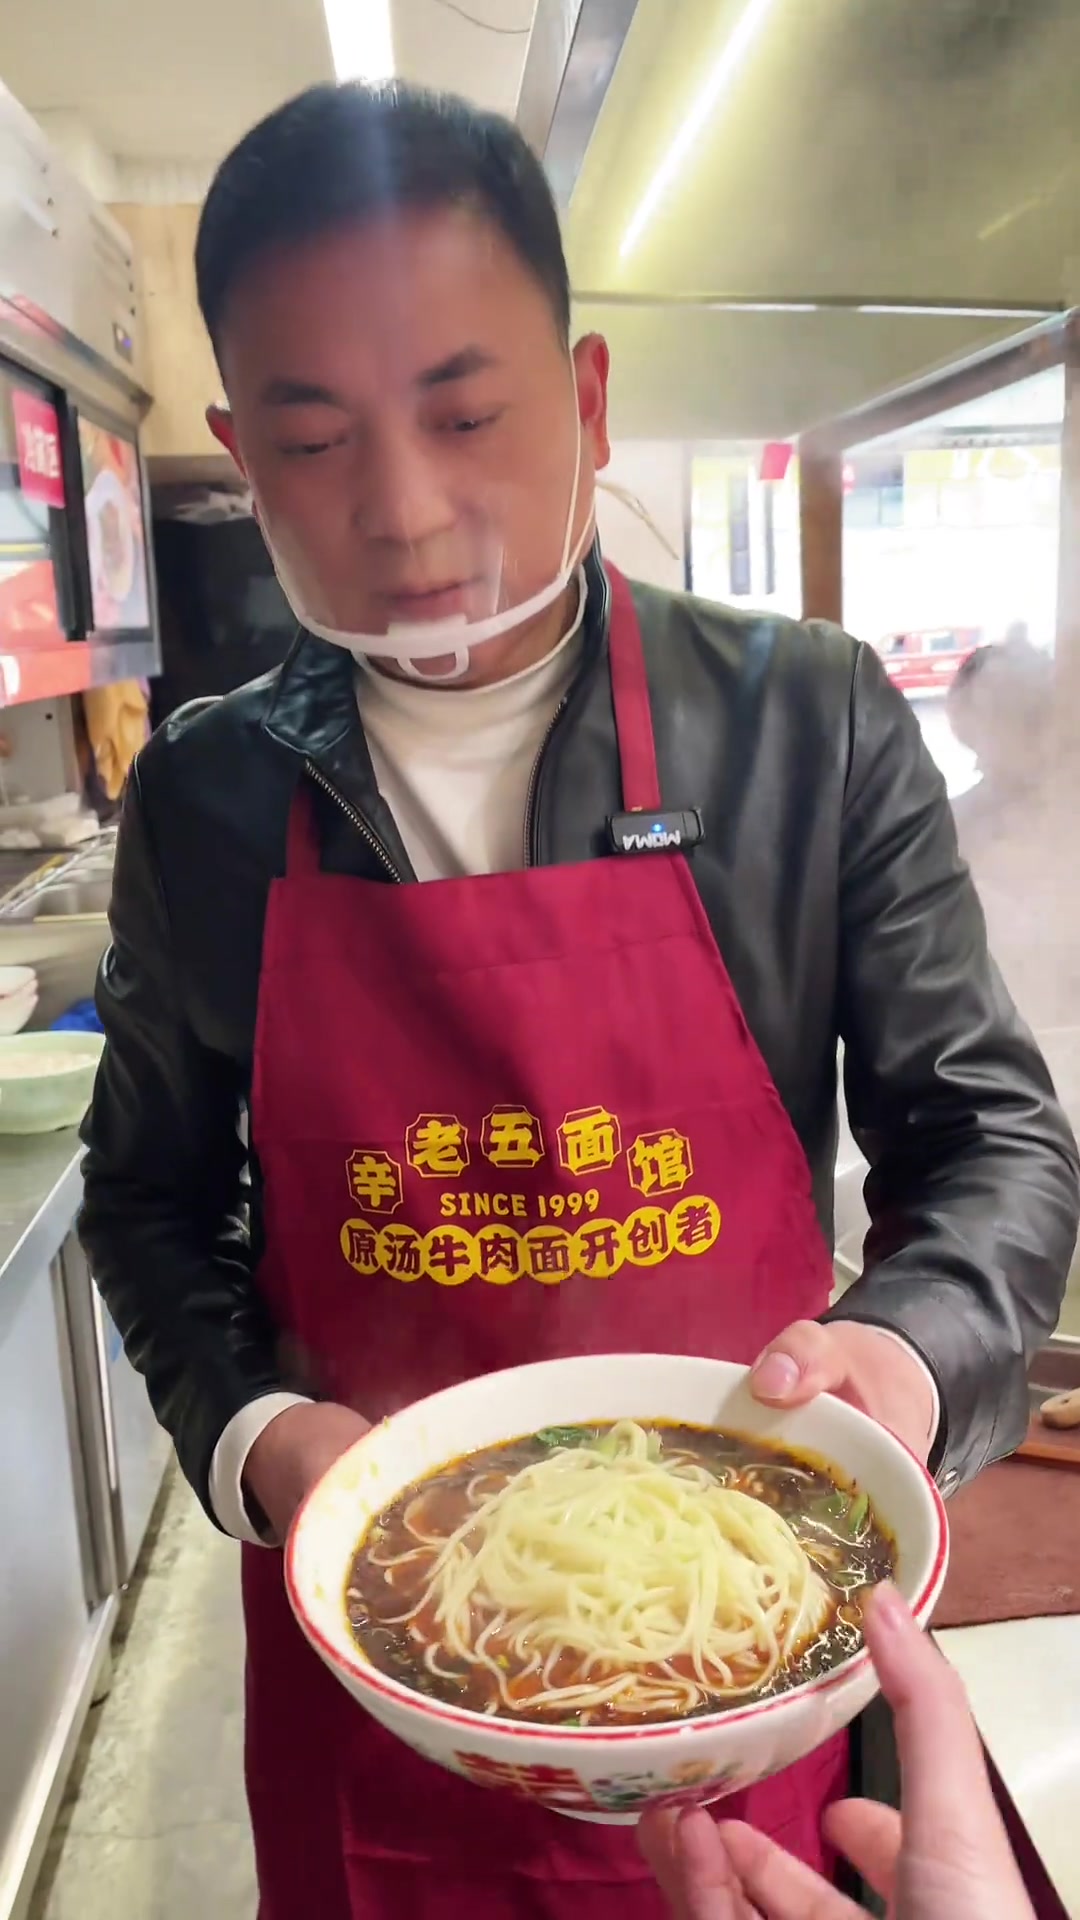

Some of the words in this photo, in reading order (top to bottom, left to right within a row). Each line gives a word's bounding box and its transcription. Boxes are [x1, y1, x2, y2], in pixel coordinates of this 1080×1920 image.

[622, 830, 681, 851] MOMA
[351, 1108, 691, 1208] 辛老五面馆
[440, 1193, 527, 1217] SINCE
[539, 1189, 599, 1218] 1999
[342, 1199, 718, 1282] 原汤牛肉面开创者
